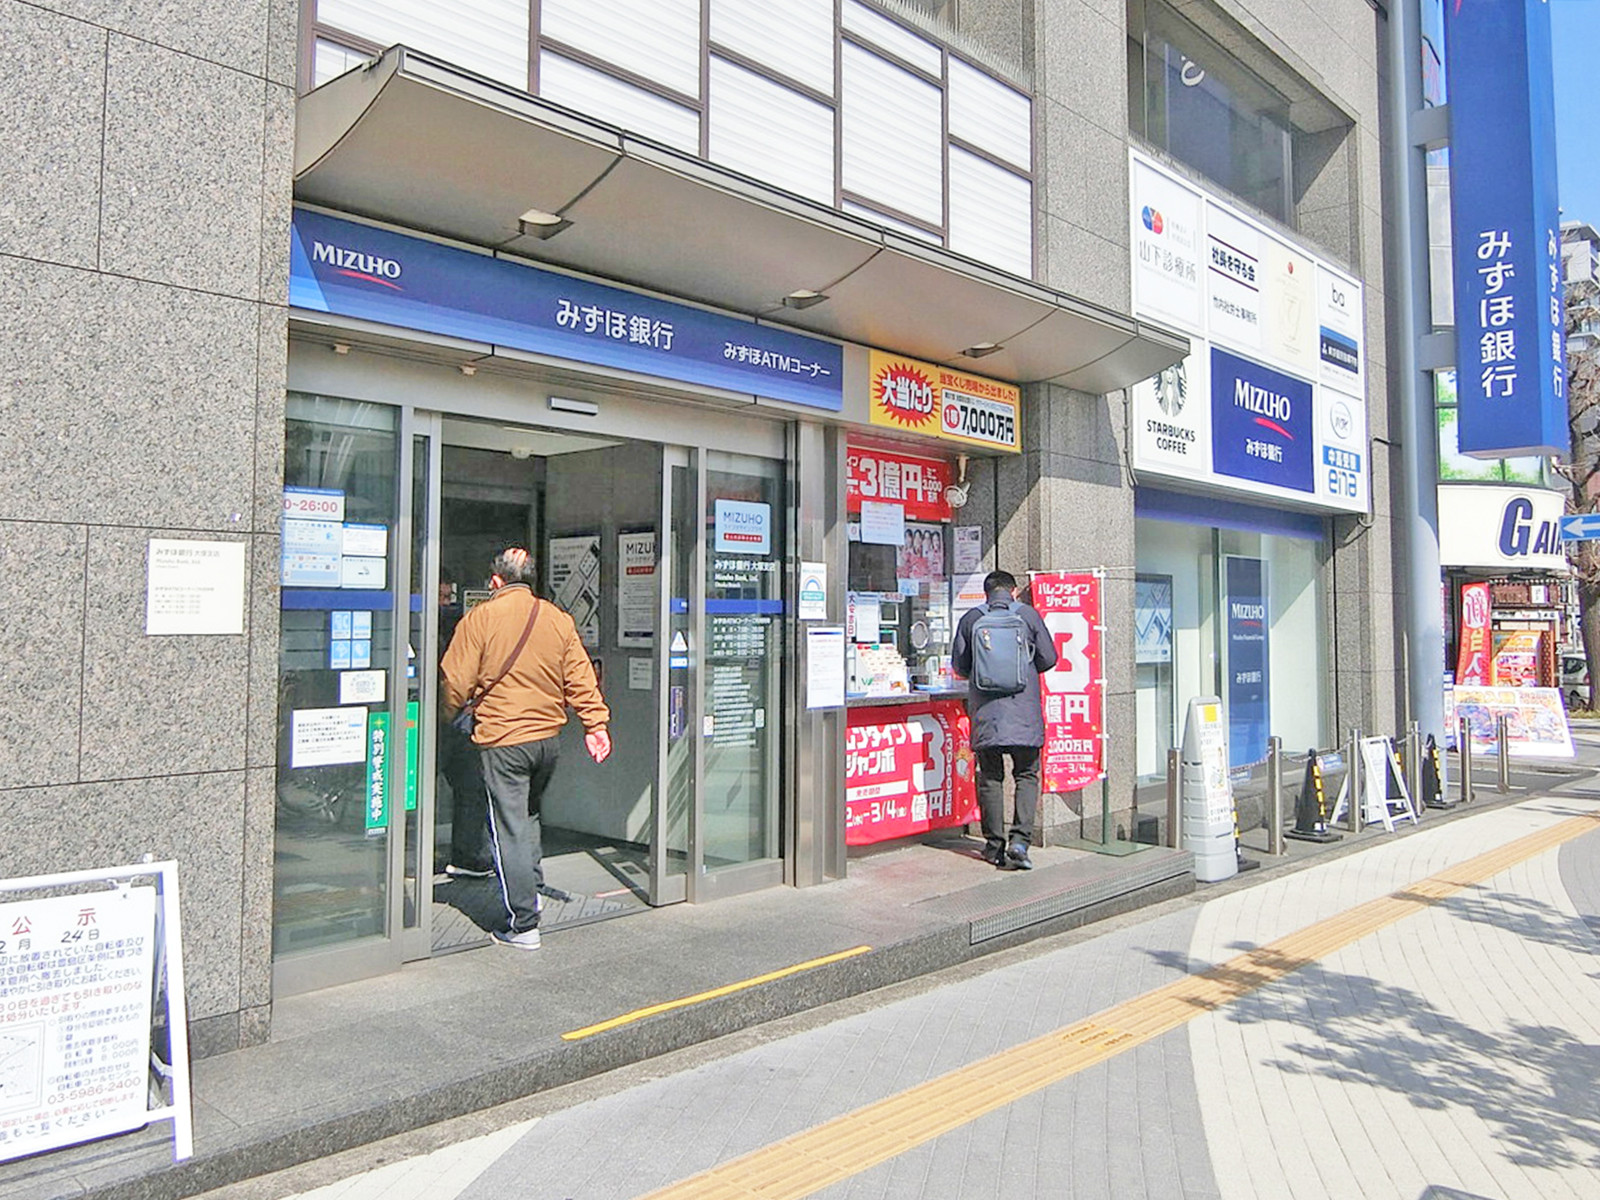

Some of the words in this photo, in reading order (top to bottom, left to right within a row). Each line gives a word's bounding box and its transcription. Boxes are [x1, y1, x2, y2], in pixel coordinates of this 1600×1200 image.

[312, 241, 402, 279] MIZUHO
[1139, 239, 1197, 283] 山下診療所
[1212, 246, 1256, 282] 社長を守る会
[555, 299, 675, 350] みずほ銀行
[1477, 229, 1517, 398] みずほ銀行
[723, 341, 832, 377] みずほATMコーナー
[881, 372, 933, 414] 大当たり
[1234, 378, 1291, 421] MIZUHO
[960, 405, 1015, 443] 7,000万円
[1147, 419, 1196, 443] STARBUCKS
[1156, 437, 1187, 455] COFFEE
[1245, 438, 1283, 463] みずほ銀行
[859, 457, 923, 502] 3億円
[1328, 469, 1357, 498] ena
[723, 511, 763, 525] MIZUHO
[1038, 583, 1090, 595] バレンタイン
[1046, 595, 1080, 607] ジャンボ
[1232, 603, 1264, 619] MIZUHO
[907, 713, 945, 792] 3
[12, 915, 32, 936] 公
[77, 907, 96, 926] 示
[18, 938, 31, 951] 月
[61, 929, 84, 943] 24
[88, 928, 100, 940] 日
[48, 1077, 141, 1105] 03-5986-2400
